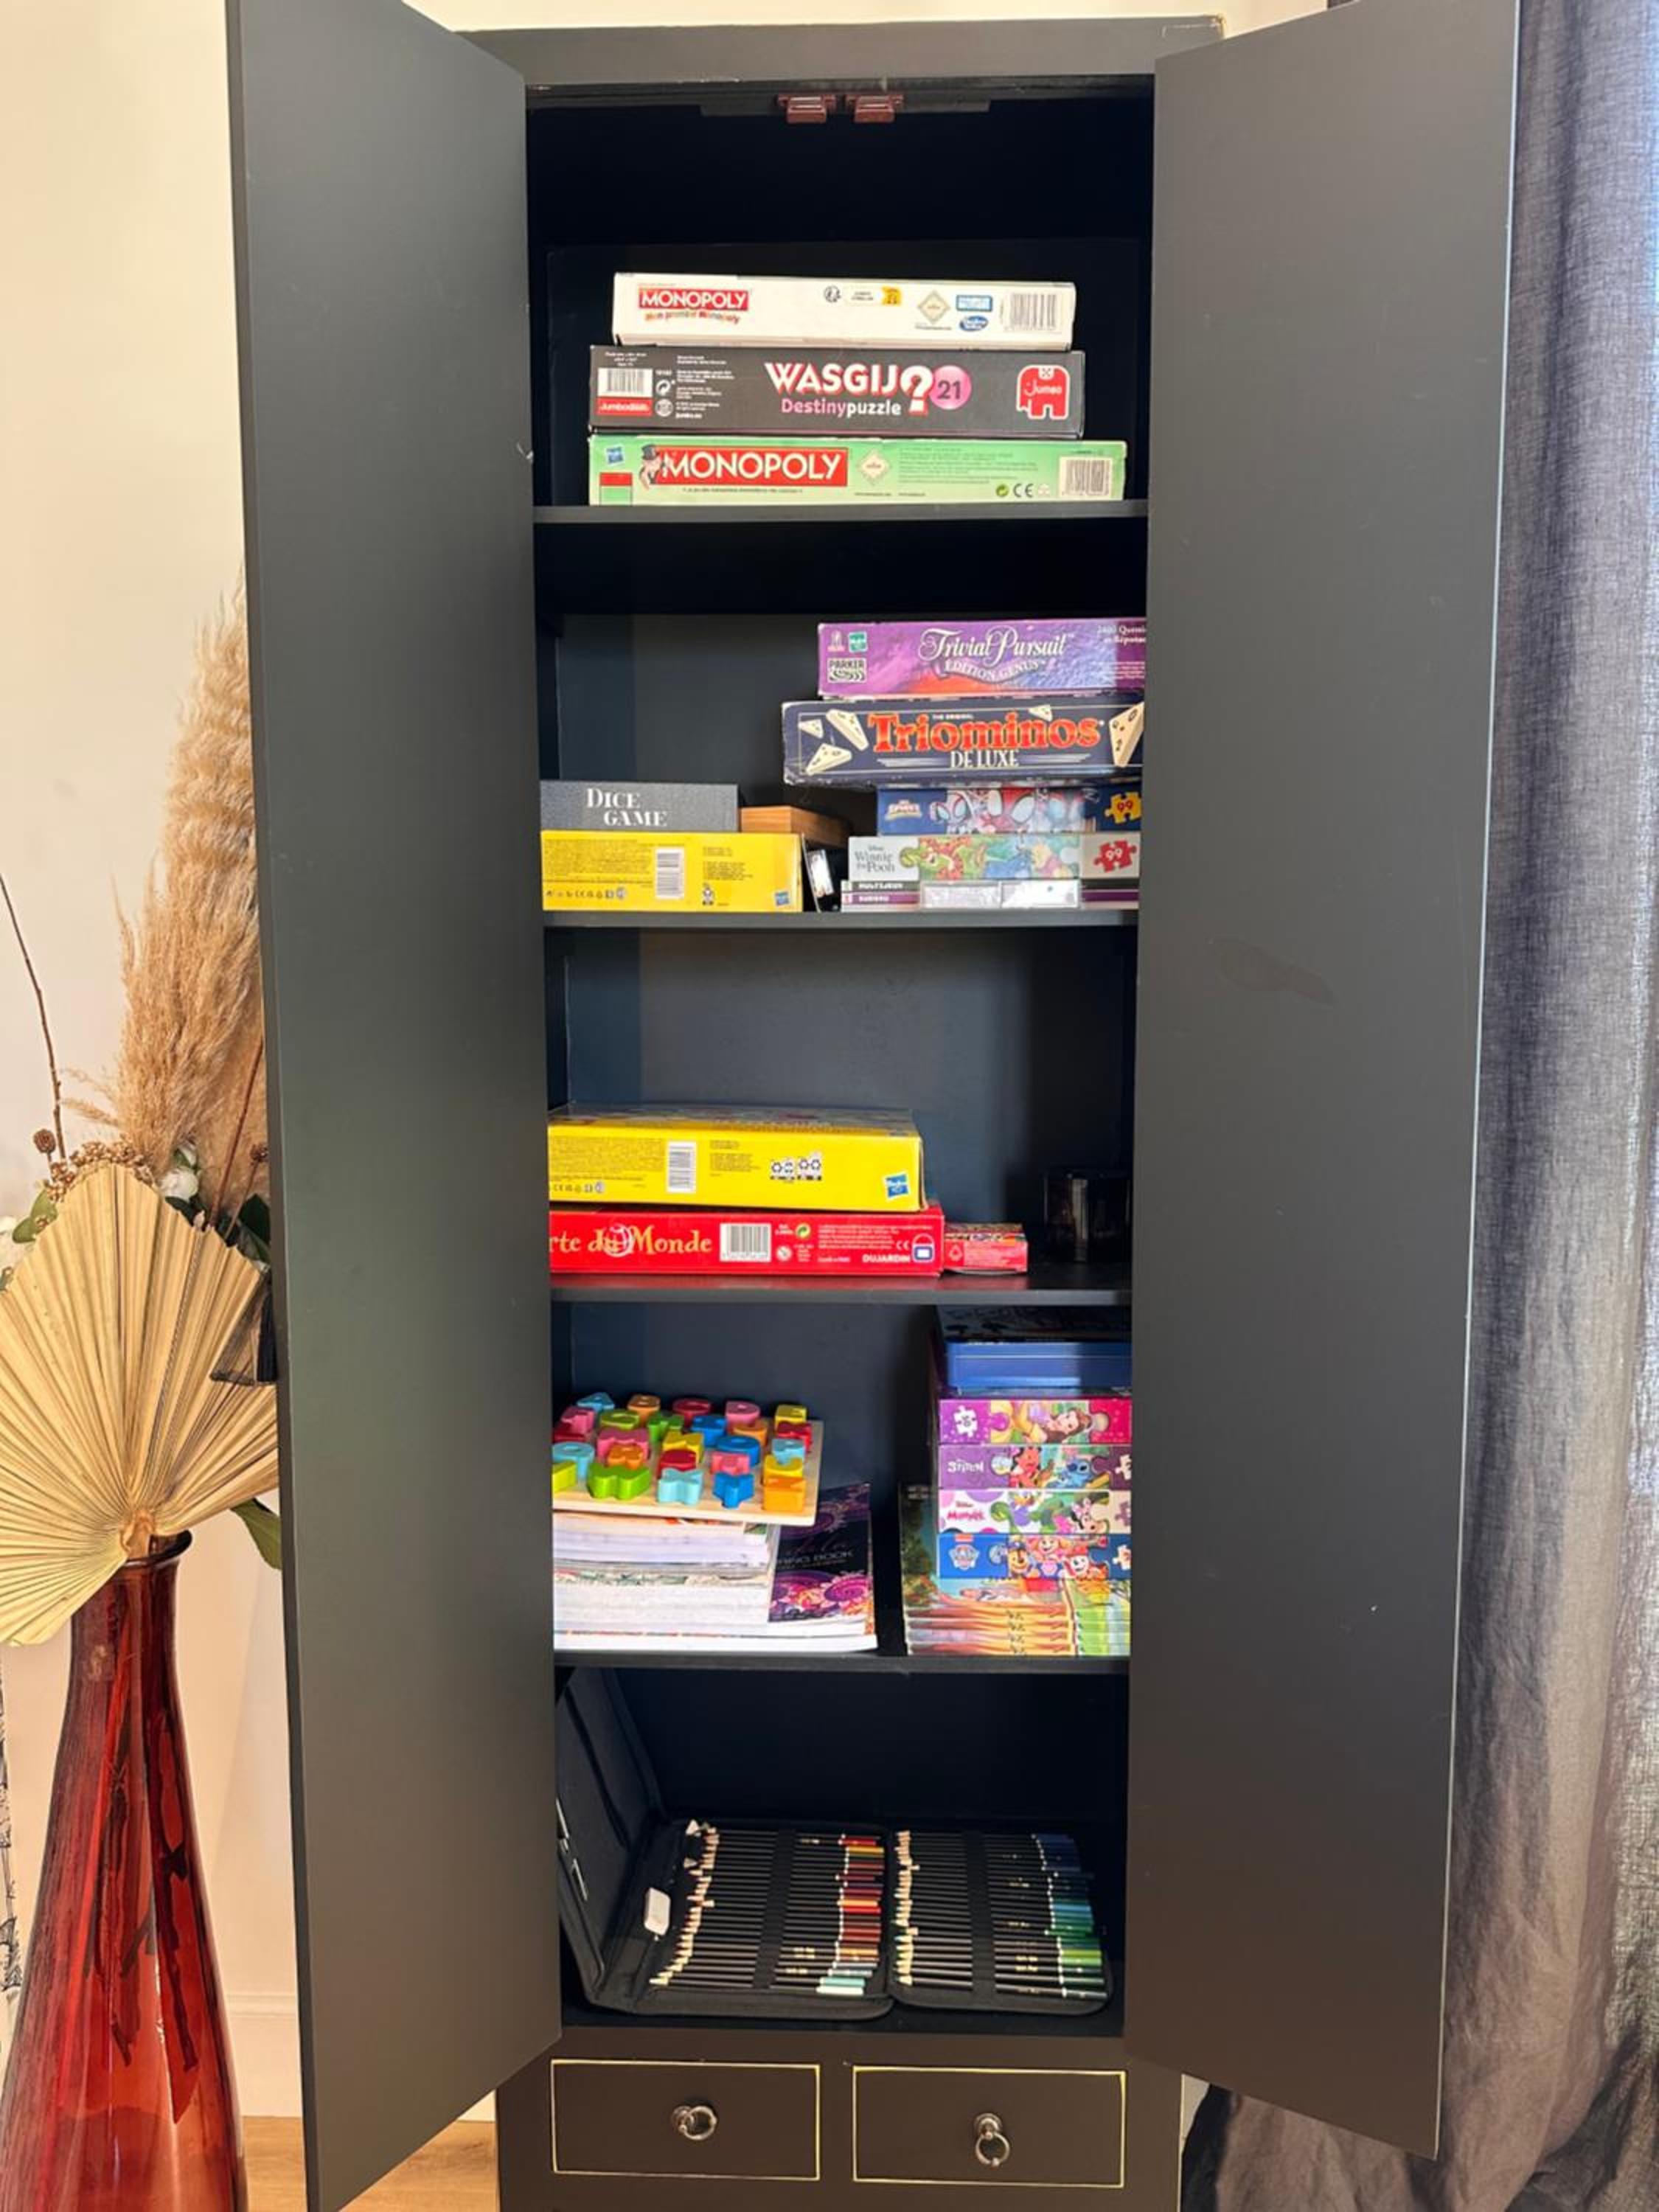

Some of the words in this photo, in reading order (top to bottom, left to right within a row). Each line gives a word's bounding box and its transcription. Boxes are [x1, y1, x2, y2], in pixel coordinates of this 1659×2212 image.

[641, 289, 746, 309] MONOPOLY
[937, 380, 961, 399] 21
[782, 397, 901, 418] Destinypuzzle
[662, 451, 841, 479] MONOPOLY
[919, 627, 993, 661] Trivial
[984, 625, 1068, 667] Pursuit
[868, 712, 1101, 752] Triominos
[950, 749, 1020, 769] DELUXE
[587, 788, 641, 808] DICE
[604, 810, 667, 826] GAME
[855, 848, 894, 861] Winnie
[1106, 848, 1123, 861] 99
[867, 860, 896, 873] Pooh
[627, 1223, 713, 1256] Monde
[862, 1253, 911, 1263] DUJARDIN
